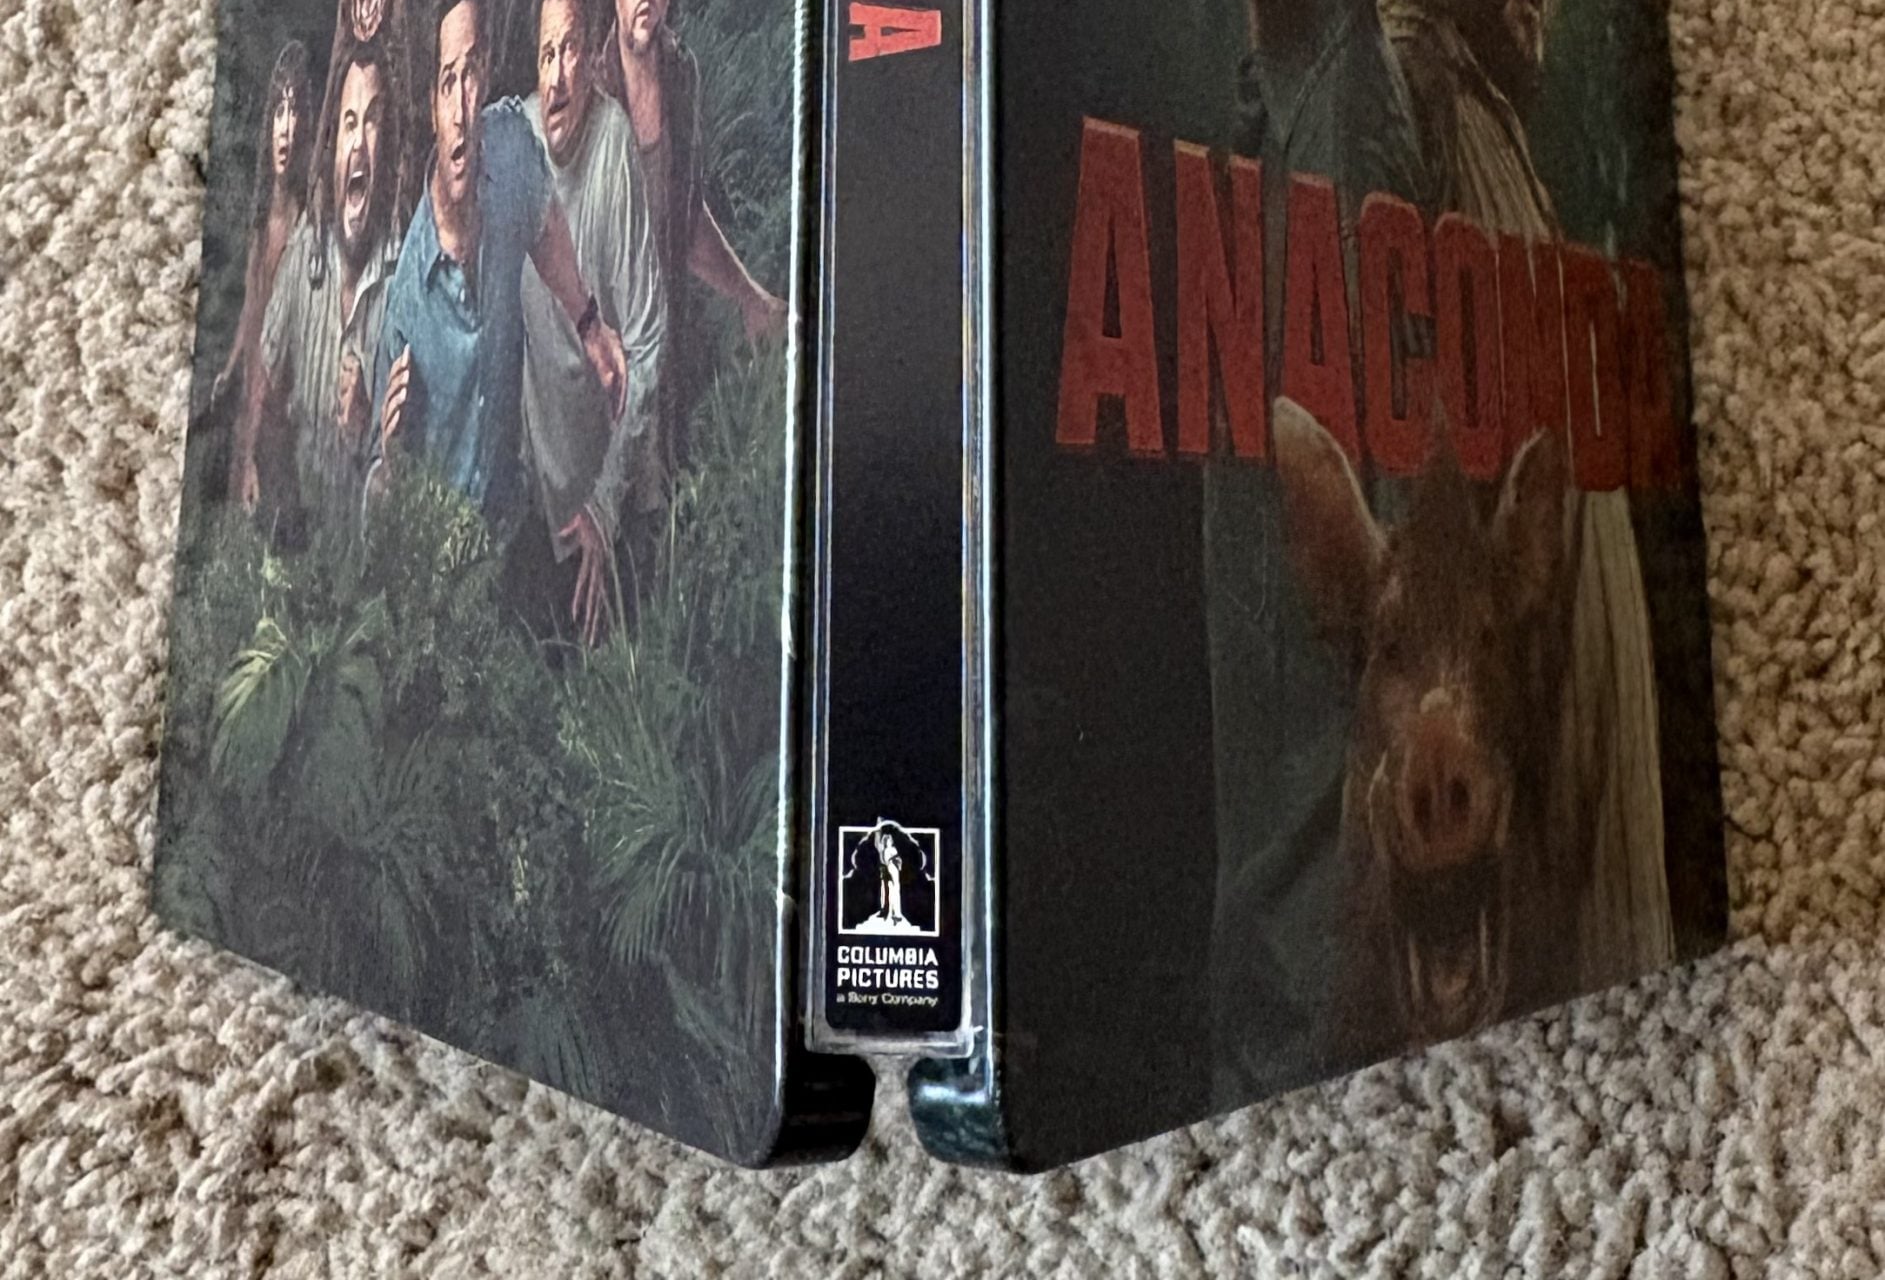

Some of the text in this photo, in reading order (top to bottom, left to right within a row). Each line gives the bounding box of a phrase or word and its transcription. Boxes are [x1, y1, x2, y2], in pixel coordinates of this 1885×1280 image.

[837, 946, 939, 966] COLUMBIA
[837, 968, 939, 988] PICTURES
[882, 993, 938, 1007] Company
